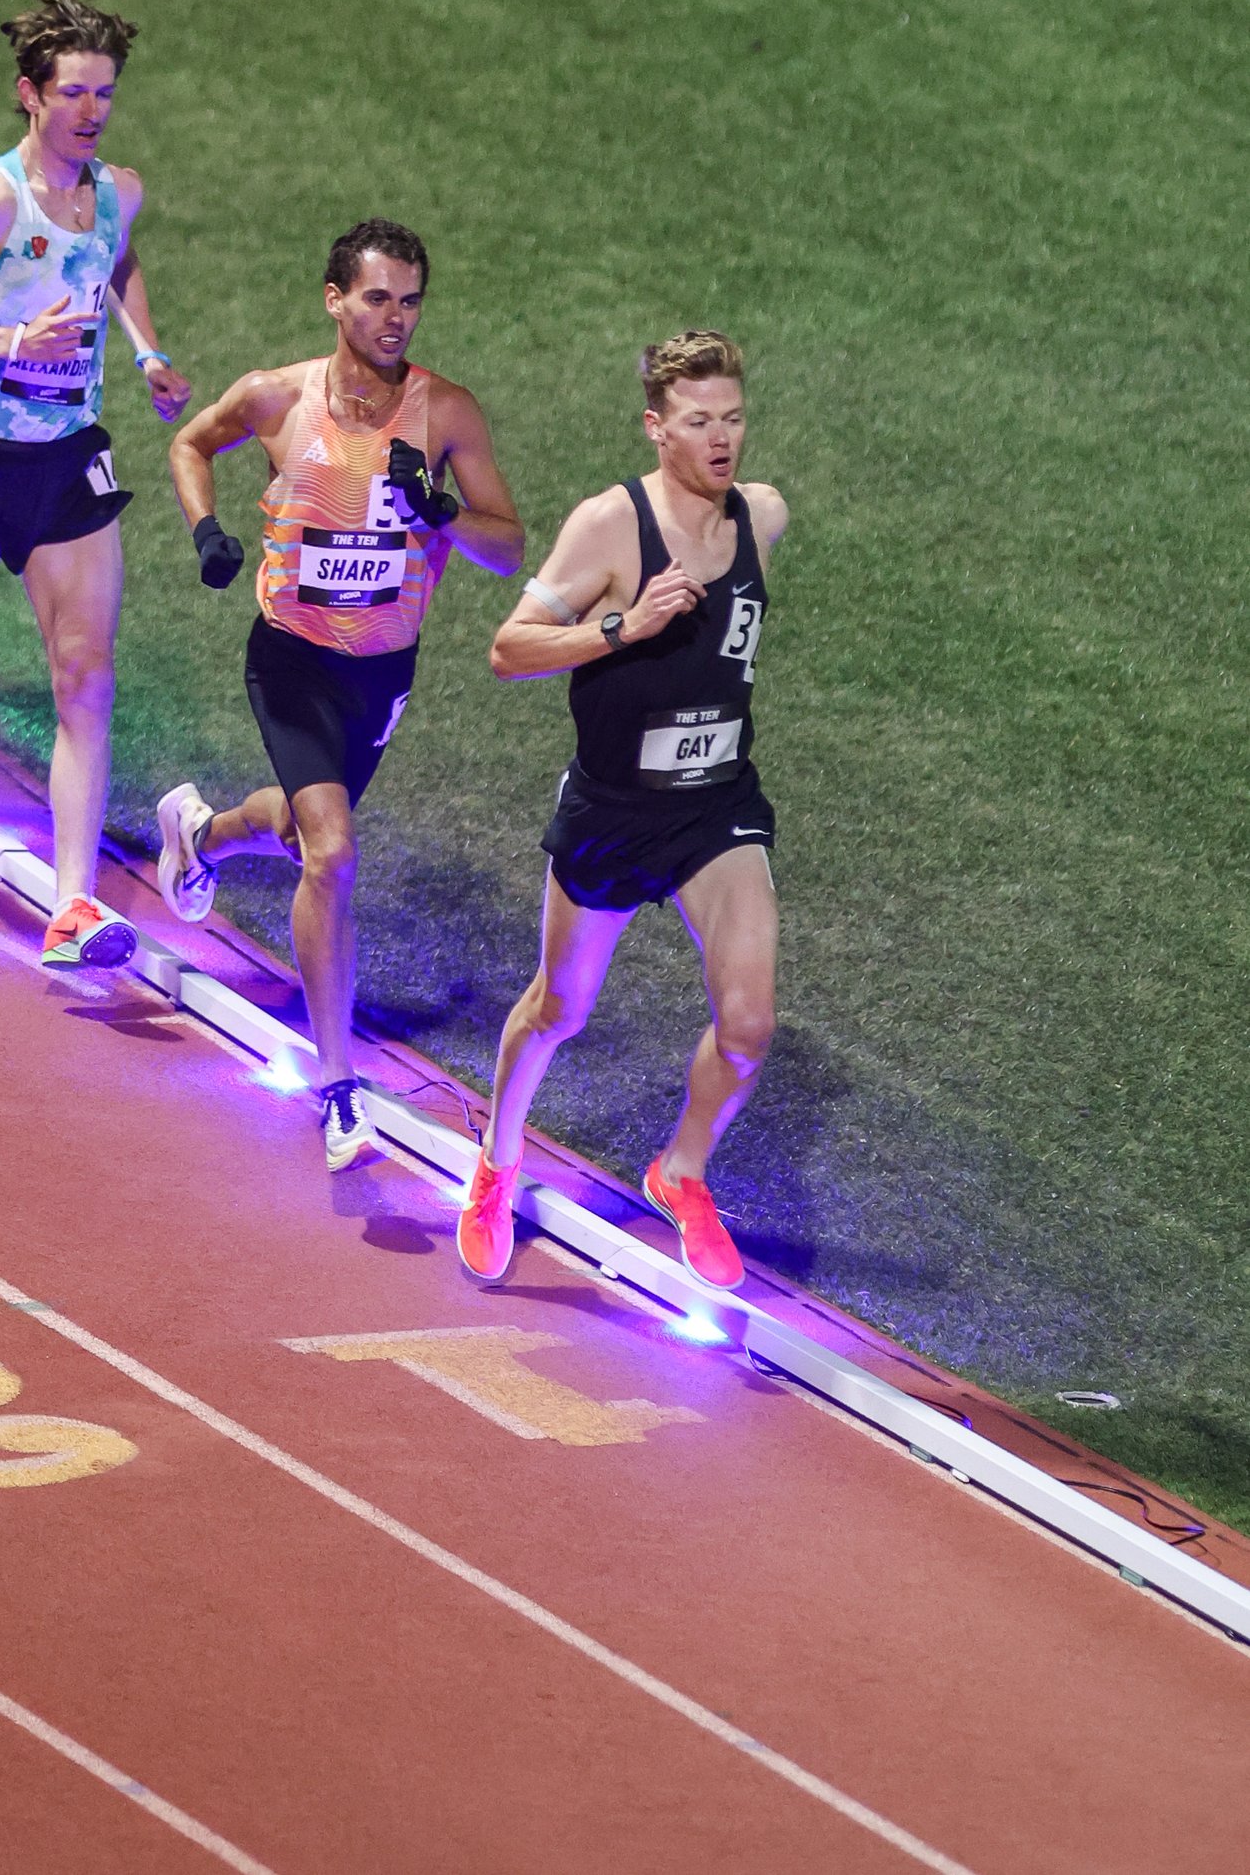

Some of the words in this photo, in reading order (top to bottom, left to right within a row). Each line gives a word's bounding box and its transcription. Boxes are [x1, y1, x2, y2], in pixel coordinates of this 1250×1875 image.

[332, 534, 354, 546] THE
[357, 536, 380, 547] TEN
[317, 558, 391, 582] SHARP
[676, 712, 699, 724] THE
[701, 710, 721, 722] TEN
[676, 733, 717, 760] GAY
